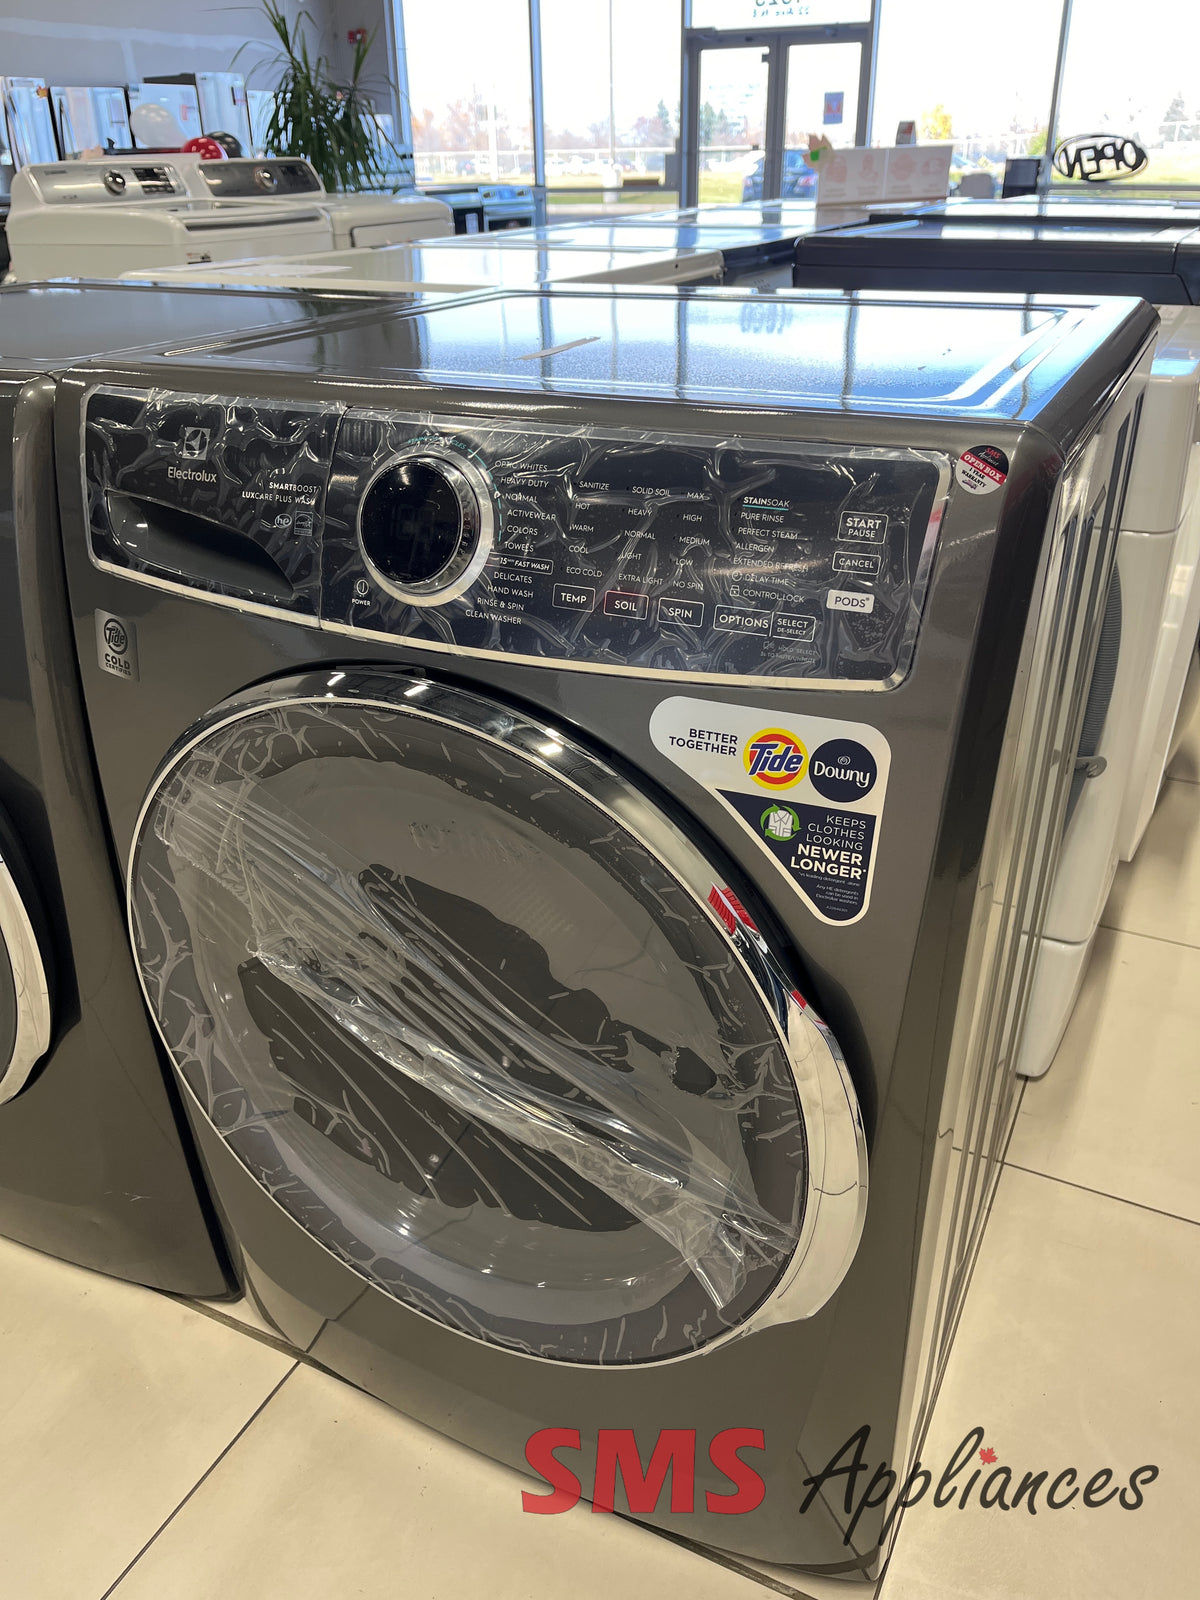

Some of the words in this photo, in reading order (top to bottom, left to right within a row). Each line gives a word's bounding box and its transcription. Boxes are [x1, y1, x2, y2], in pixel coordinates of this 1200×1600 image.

[520, 462, 548, 472] WHITES
[964, 454, 985, 470] OPEN
[984, 466, 1003, 481] BOX
[167, 466, 217, 484] Electrolux
[961, 469, 987, 488] WARRANTY
[973, 469, 985, 480] YEAR
[269, 482, 317, 493] SMARTBOOST
[500, 477, 526, 486] HEAVY
[528, 479, 549, 488] DUTY
[579, 480, 610, 491] SANITIZE
[242, 491, 273, 501] LUXCARE
[275, 495, 292, 503] PLUS
[632, 486, 653, 495] SOLID
[655, 488, 671, 497] SOIL
[686, 491, 705, 500] MAX
[505, 493, 537, 504] NORMAL
[743, 496, 790, 507] STAINSOAK
[575, 503, 590, 511] HOT
[628, 508, 653, 517] HEAVY
[277, 515, 290, 526] he
[507, 509, 556, 521] ACTIVEWEAR
[683, 514, 703, 522] HIGH
[740, 511, 760, 520] PURE
[761, 513, 784, 523] RINSE
[572, 523, 594, 533] WARM
[845, 517, 882, 530] START
[507, 525, 538, 536] COLORS
[624, 530, 656, 540] NORMAL
[738, 527, 770, 537] PERFECT
[771, 530, 798, 540] STEAM
[847, 528, 876, 539] PAUSE
[679, 536, 710, 546] MEDIUM
[568, 544, 589, 554] COOL
[735, 542, 775, 553] ALLERGEN
[514, 560, 530, 568] FAST
[530, 562, 550, 571] WASH
[675, 559, 693, 567] LOW
[733, 557, 773, 569] EXTENDED
[838, 557, 875, 569] CANCEL
[493, 571, 532, 584] DELICATES
[566, 566, 581, 575] ECO
[582, 568, 603, 578] COLD
[619, 573, 641, 583] EXTRA
[642, 575, 663, 585] LIGHT
[745, 573, 770, 583] DELAY
[771, 576, 789, 585] TIME
[487, 585, 510, 595] HAND
[511, 588, 534, 598] WASH
[672, 580, 686, 588] NO
[686, 581, 703, 591] SPIN
[560, 592, 587, 604] TEMP
[742, 588, 782, 600] CONTROL
[782, 593, 805, 603] LOCK
[351, 598, 371, 607] POWER
[477, 597, 498, 607] RINSE
[499, 600, 506, 608] &
[507, 602, 525, 611] SPIN
[614, 600, 637, 612] SOIL
[465, 609, 489, 619] CLEAN
[489, 613, 522, 625] WASHER
[668, 607, 693, 619] SPIN
[719, 614, 769, 630] OPTIONS
[777, 617, 809, 629] SELECT
[106, 626, 125, 645] Tide
[776, 627, 807, 636] DE-SELECT
[104, 653, 130, 670] COLD
[106, 662, 132, 676] CERTIFIED
[689, 728, 738, 745] BETTER
[669, 736, 737, 757] TOGETHER
[749, 742, 804, 776] Tide
[813, 760, 871, 788] Downy
[826, 814, 867, 830] KEEPS
[807, 823, 865, 840] CLOTHES
[806, 833, 863, 851] LOOKING
[797, 843, 863, 866] NEWER
